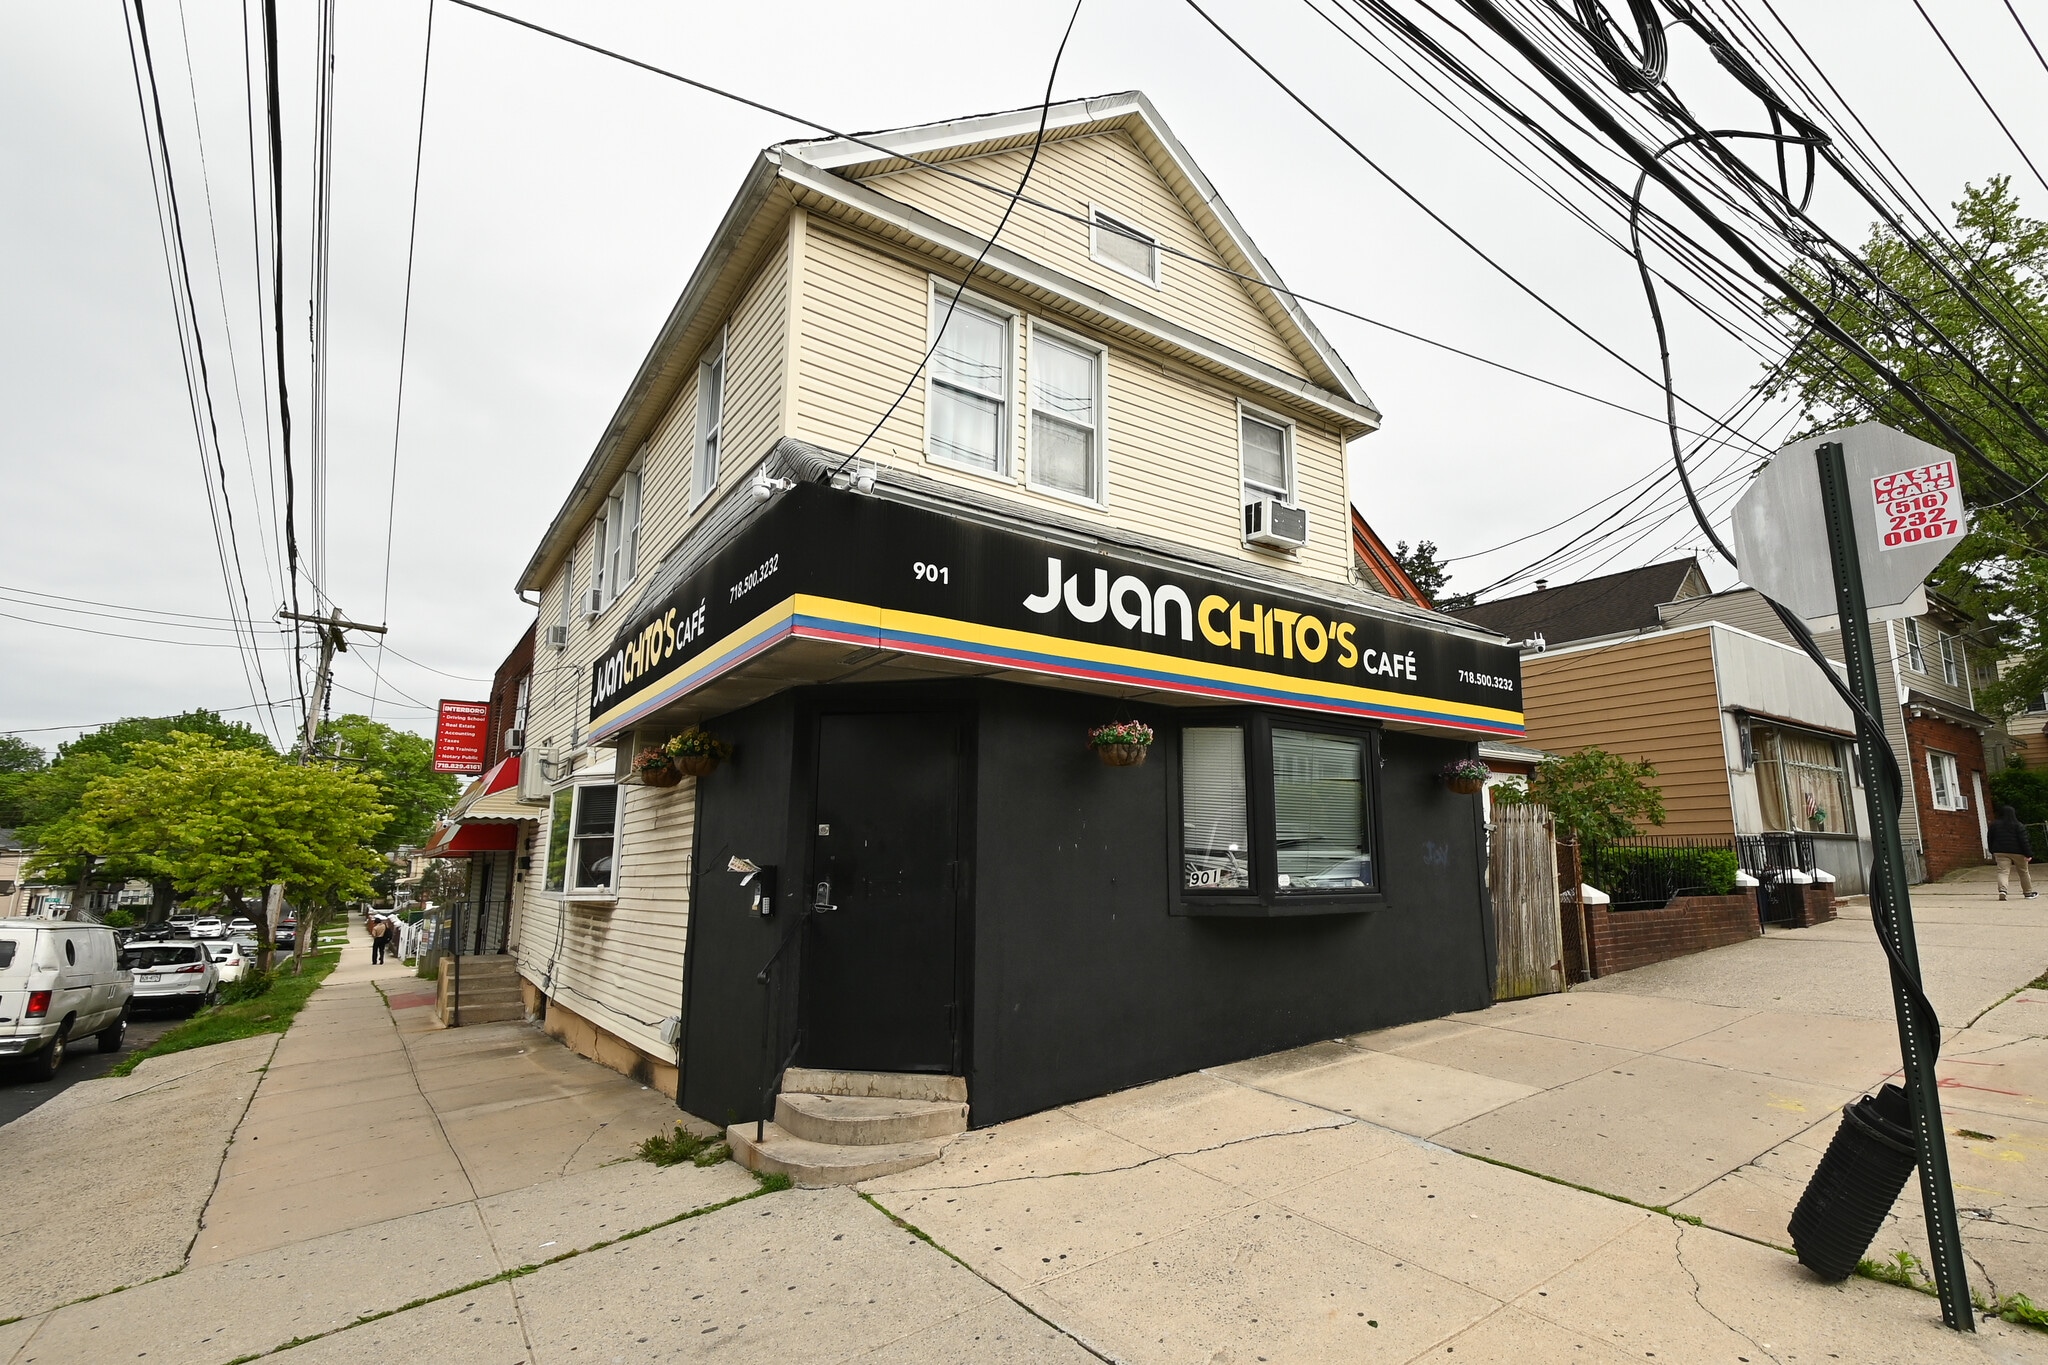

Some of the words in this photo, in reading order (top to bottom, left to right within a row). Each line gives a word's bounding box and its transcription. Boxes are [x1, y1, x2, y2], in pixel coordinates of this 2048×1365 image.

[1876, 463, 1950, 491] CASH
[1885, 491, 1949, 517] (516)
[1889, 507, 1947, 531] 232
[1883, 519, 1958, 547] 0007
[728, 553, 779, 604] 718.500.3232
[913, 561, 949, 585] 901
[676, 597, 706, 650] CAFÉ
[1363, 650, 1418, 681] CAFÉ
[1458, 669, 1514, 692] 718.500.3232
[1191, 871, 1217, 885] 901
